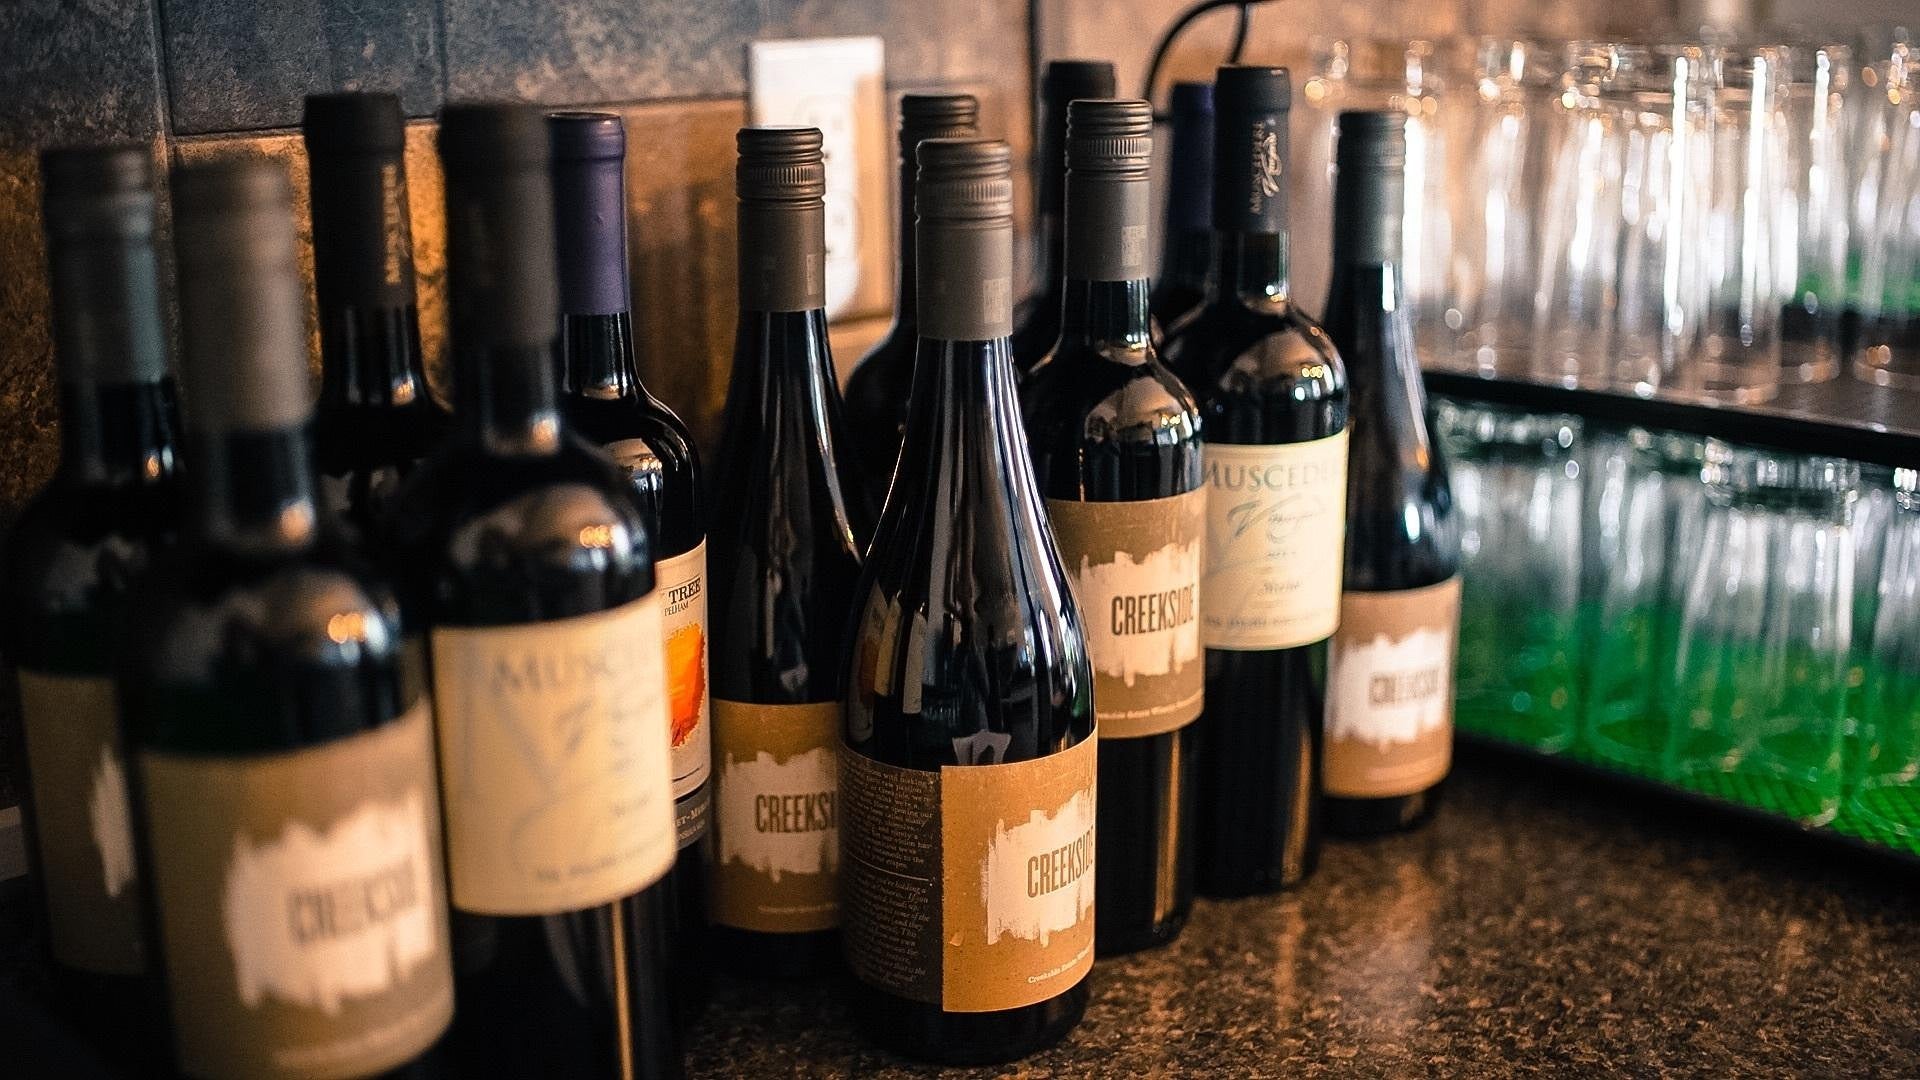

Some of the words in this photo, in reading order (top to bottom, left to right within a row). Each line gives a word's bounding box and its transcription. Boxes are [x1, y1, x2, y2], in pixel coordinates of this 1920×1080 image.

[664, 600, 689, 616] PELHAM
[668, 577, 701, 605] TREE
[1111, 583, 1194, 636] CREEKSIDE
[756, 791, 836, 833] CREEKSI
